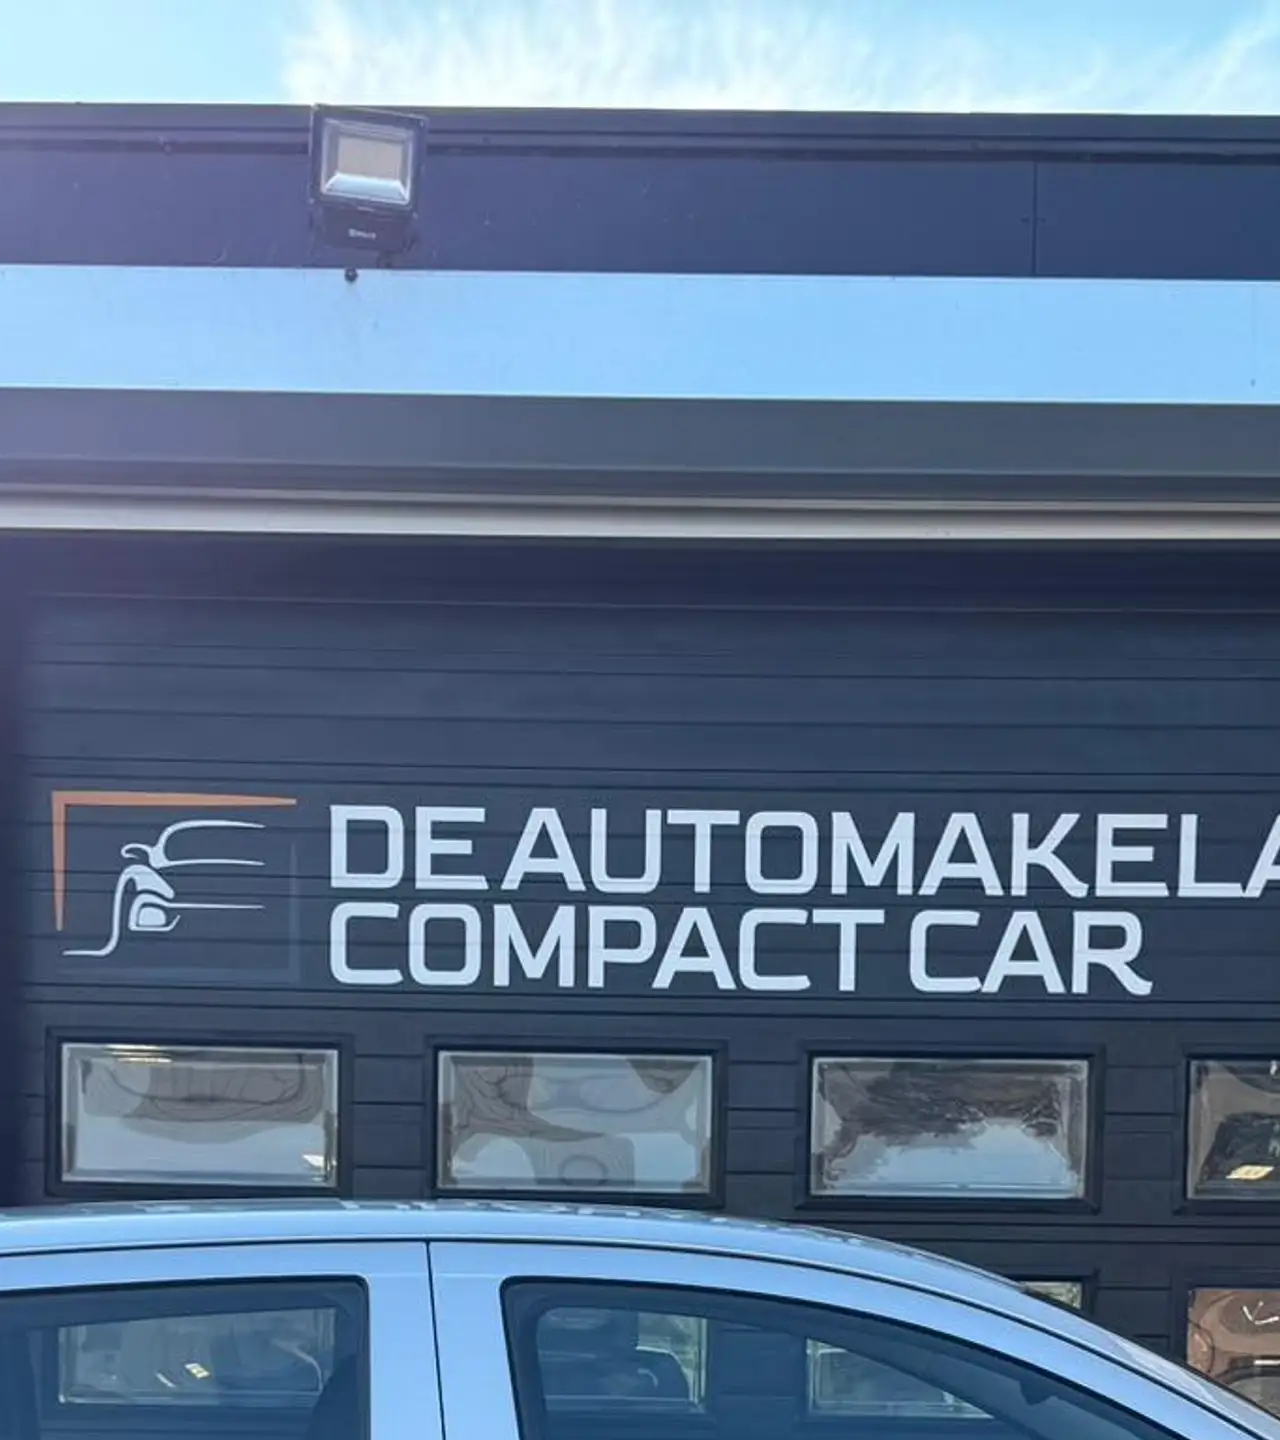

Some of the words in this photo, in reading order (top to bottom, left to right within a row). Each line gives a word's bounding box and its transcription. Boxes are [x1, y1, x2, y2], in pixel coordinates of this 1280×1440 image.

[329, 805, 488, 891] DE
[329, 902, 884, 991] COMPACT
[909, 910, 1153, 995] CAR
